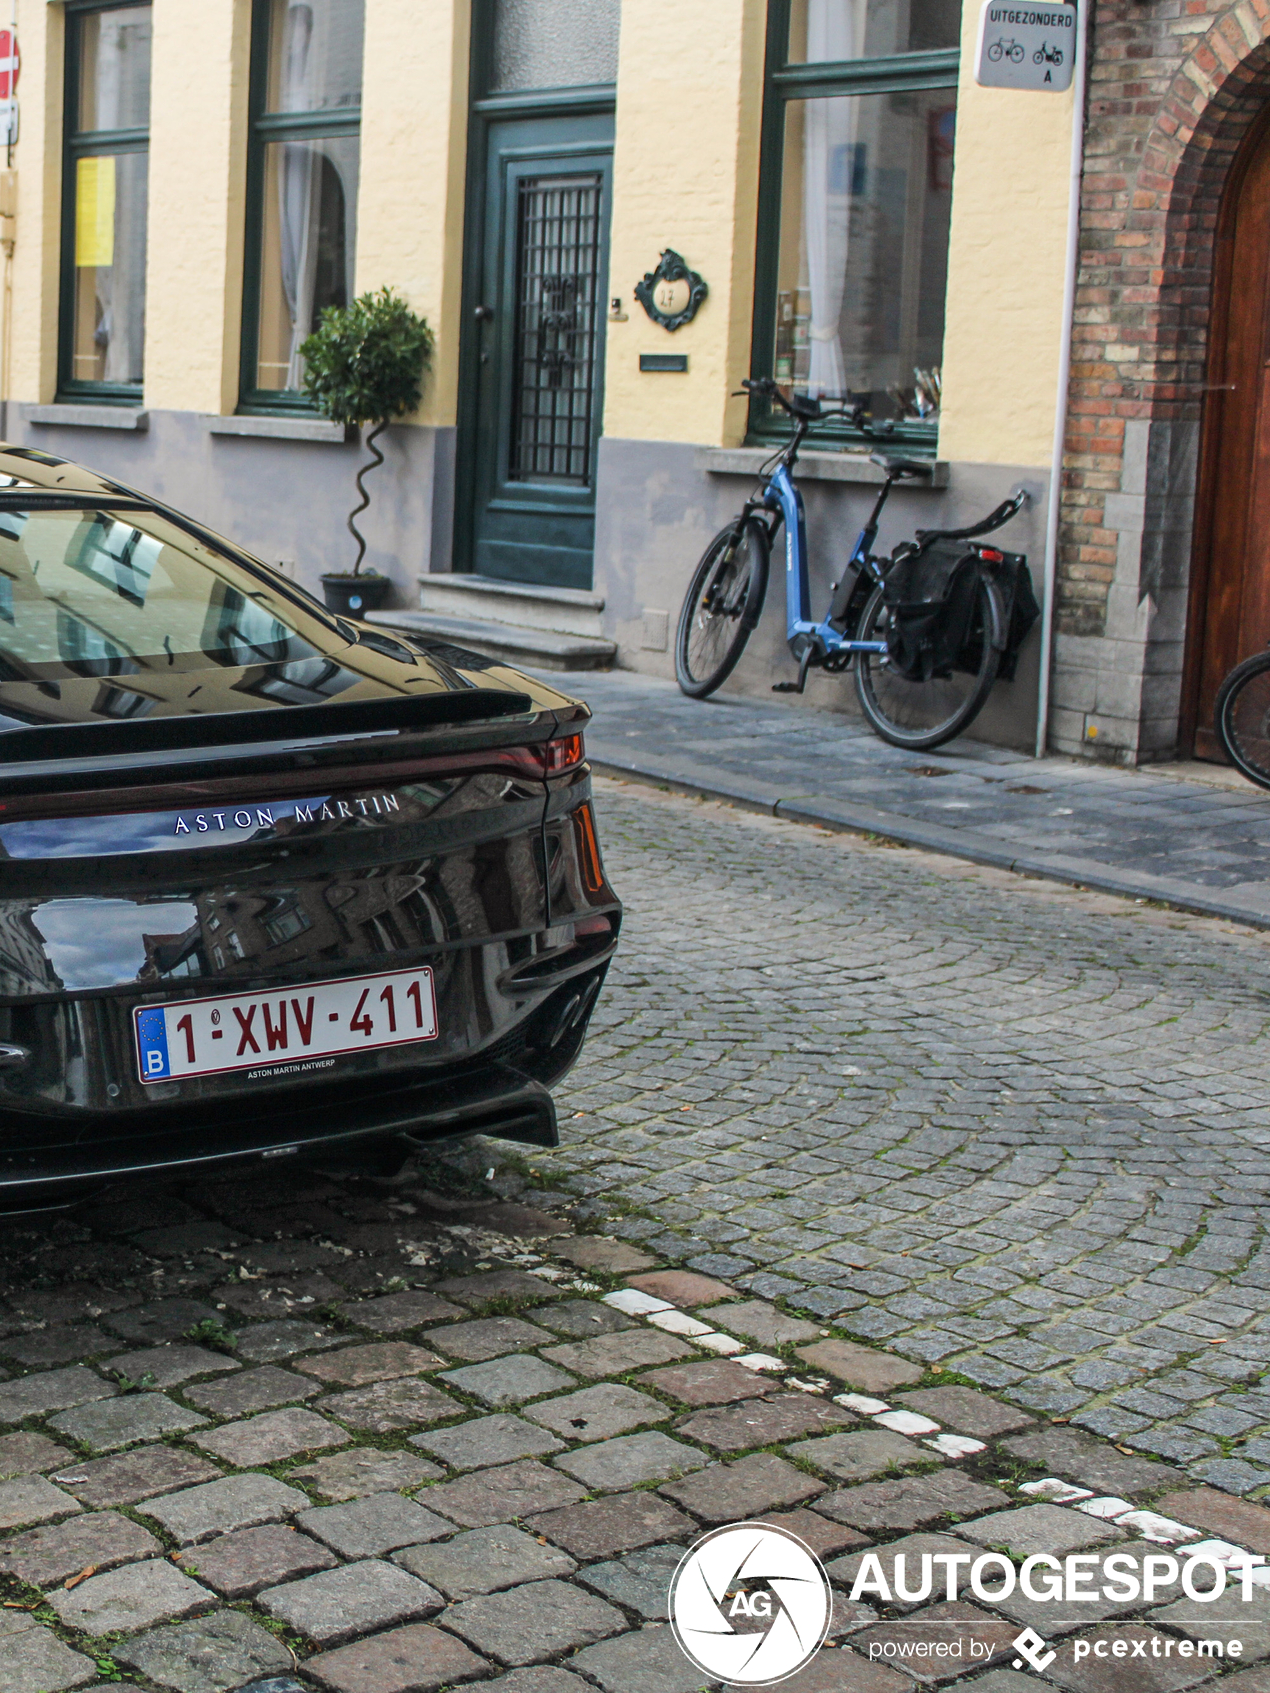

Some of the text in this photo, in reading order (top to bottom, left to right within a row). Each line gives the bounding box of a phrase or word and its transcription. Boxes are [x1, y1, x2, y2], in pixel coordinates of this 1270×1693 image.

[990, 9, 1072, 28] UITGEZONDERD
[1043, 69, 1052, 83] A
[175, 794, 401, 835] ASTON MARTIN
[147, 1050, 164, 1074] B
[247, 1059, 335, 1079] ASTON MARTIN ANTWERP
